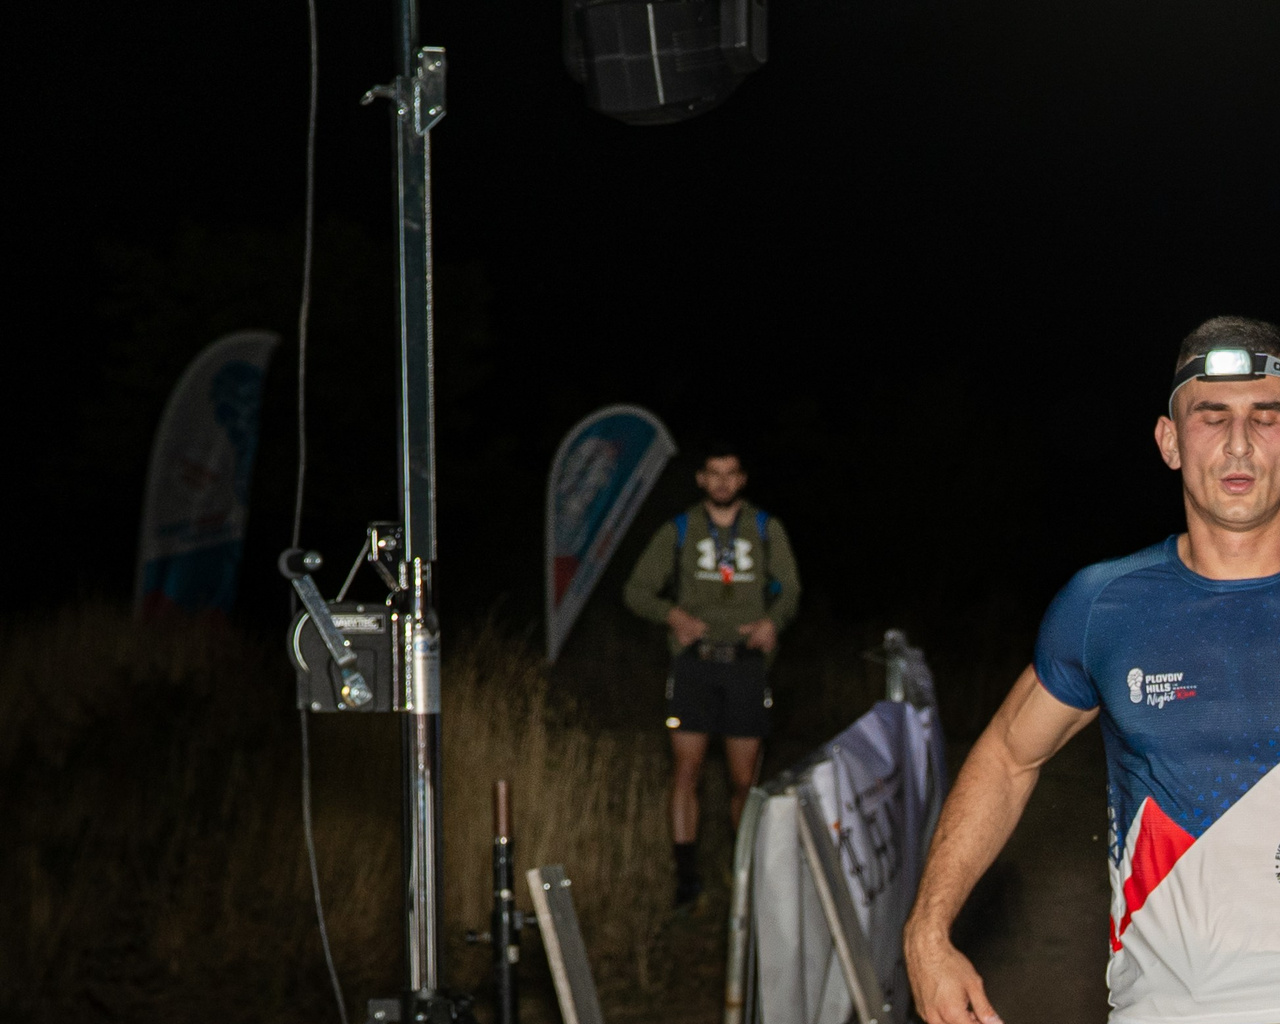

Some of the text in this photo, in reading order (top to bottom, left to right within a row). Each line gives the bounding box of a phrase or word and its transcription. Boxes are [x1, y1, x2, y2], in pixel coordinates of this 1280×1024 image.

[1145, 672, 1183, 685] PLOVDIV
[1146, 682, 1171, 694] HILLS
[1146, 690, 1177, 709] Night
